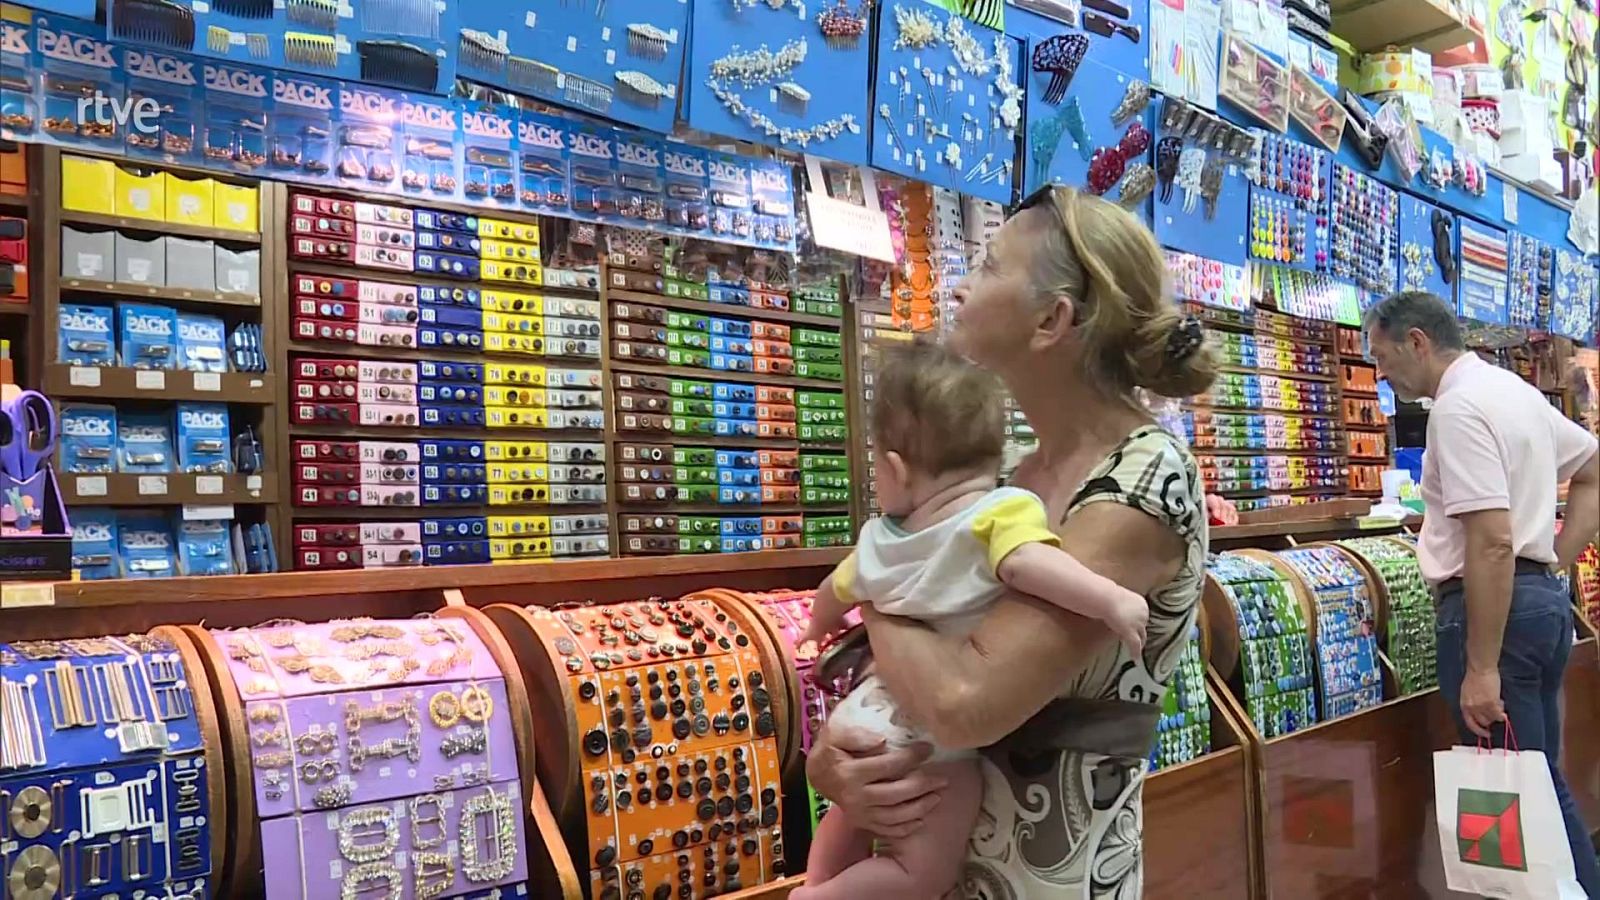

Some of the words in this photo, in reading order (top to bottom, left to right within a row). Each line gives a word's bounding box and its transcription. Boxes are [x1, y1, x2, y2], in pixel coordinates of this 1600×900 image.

[38, 27, 117, 67] PACK
[126, 51, 197, 85] PACK
[203, 65, 268, 97] PACK
[273, 79, 334, 109] PACK
[339, 90, 396, 117] PACK
[401, 103, 457, 130] PACK
[462, 112, 514, 138] PACK
[519, 122, 565, 149] PACK
[569, 133, 612, 159] PACK
[616, 142, 660, 167] PACK
[664, 152, 706, 177] PACK
[709, 162, 747, 185] PACK
[751, 170, 788, 192] PACK
[60, 315, 109, 332] PACK
[127, 317, 172, 335] PACK
[179, 325, 221, 341] PACK
[63, 419, 112, 436] PACK
[182, 411, 225, 429] PACK
[72, 524, 112, 541] ACK
[123, 532, 168, 549] PACK
